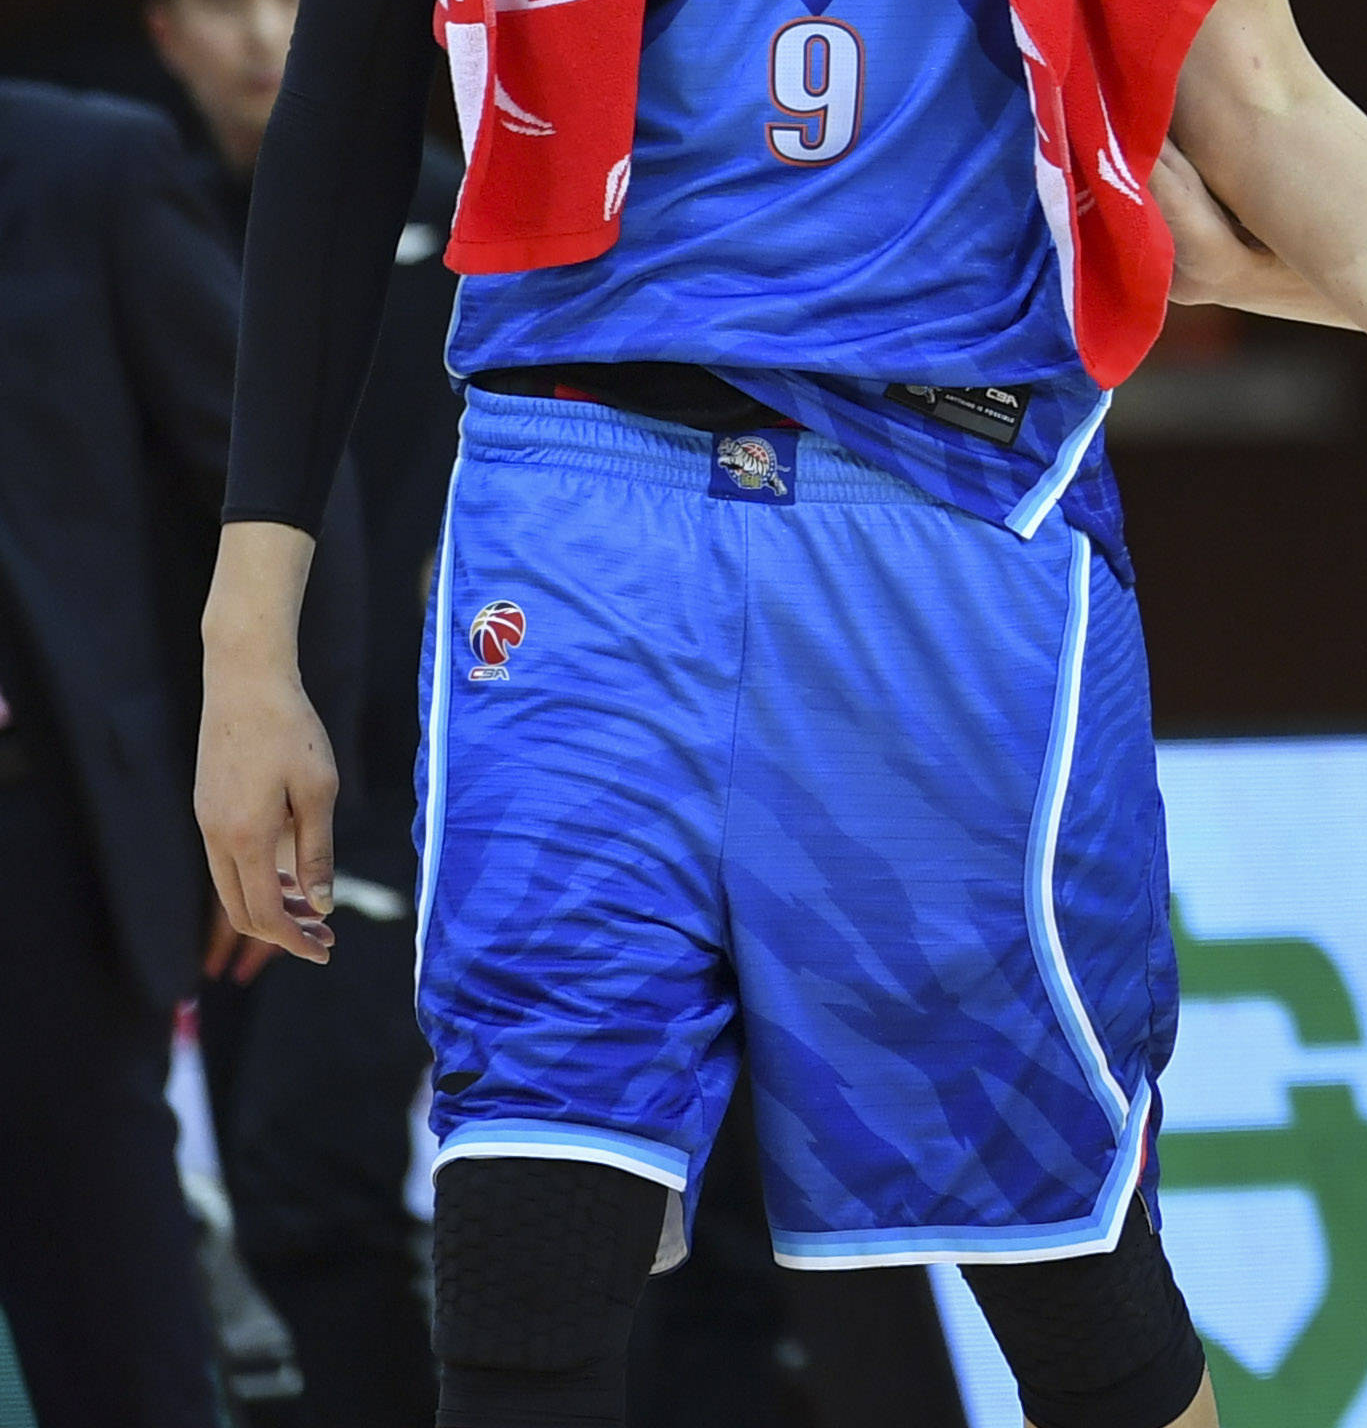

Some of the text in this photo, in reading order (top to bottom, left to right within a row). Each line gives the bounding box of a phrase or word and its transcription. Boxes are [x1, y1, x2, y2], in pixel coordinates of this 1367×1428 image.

[764, 16, 866, 165] 9
[986, 387, 1018, 408] CBA
[468, 666, 510, 681] CBA
